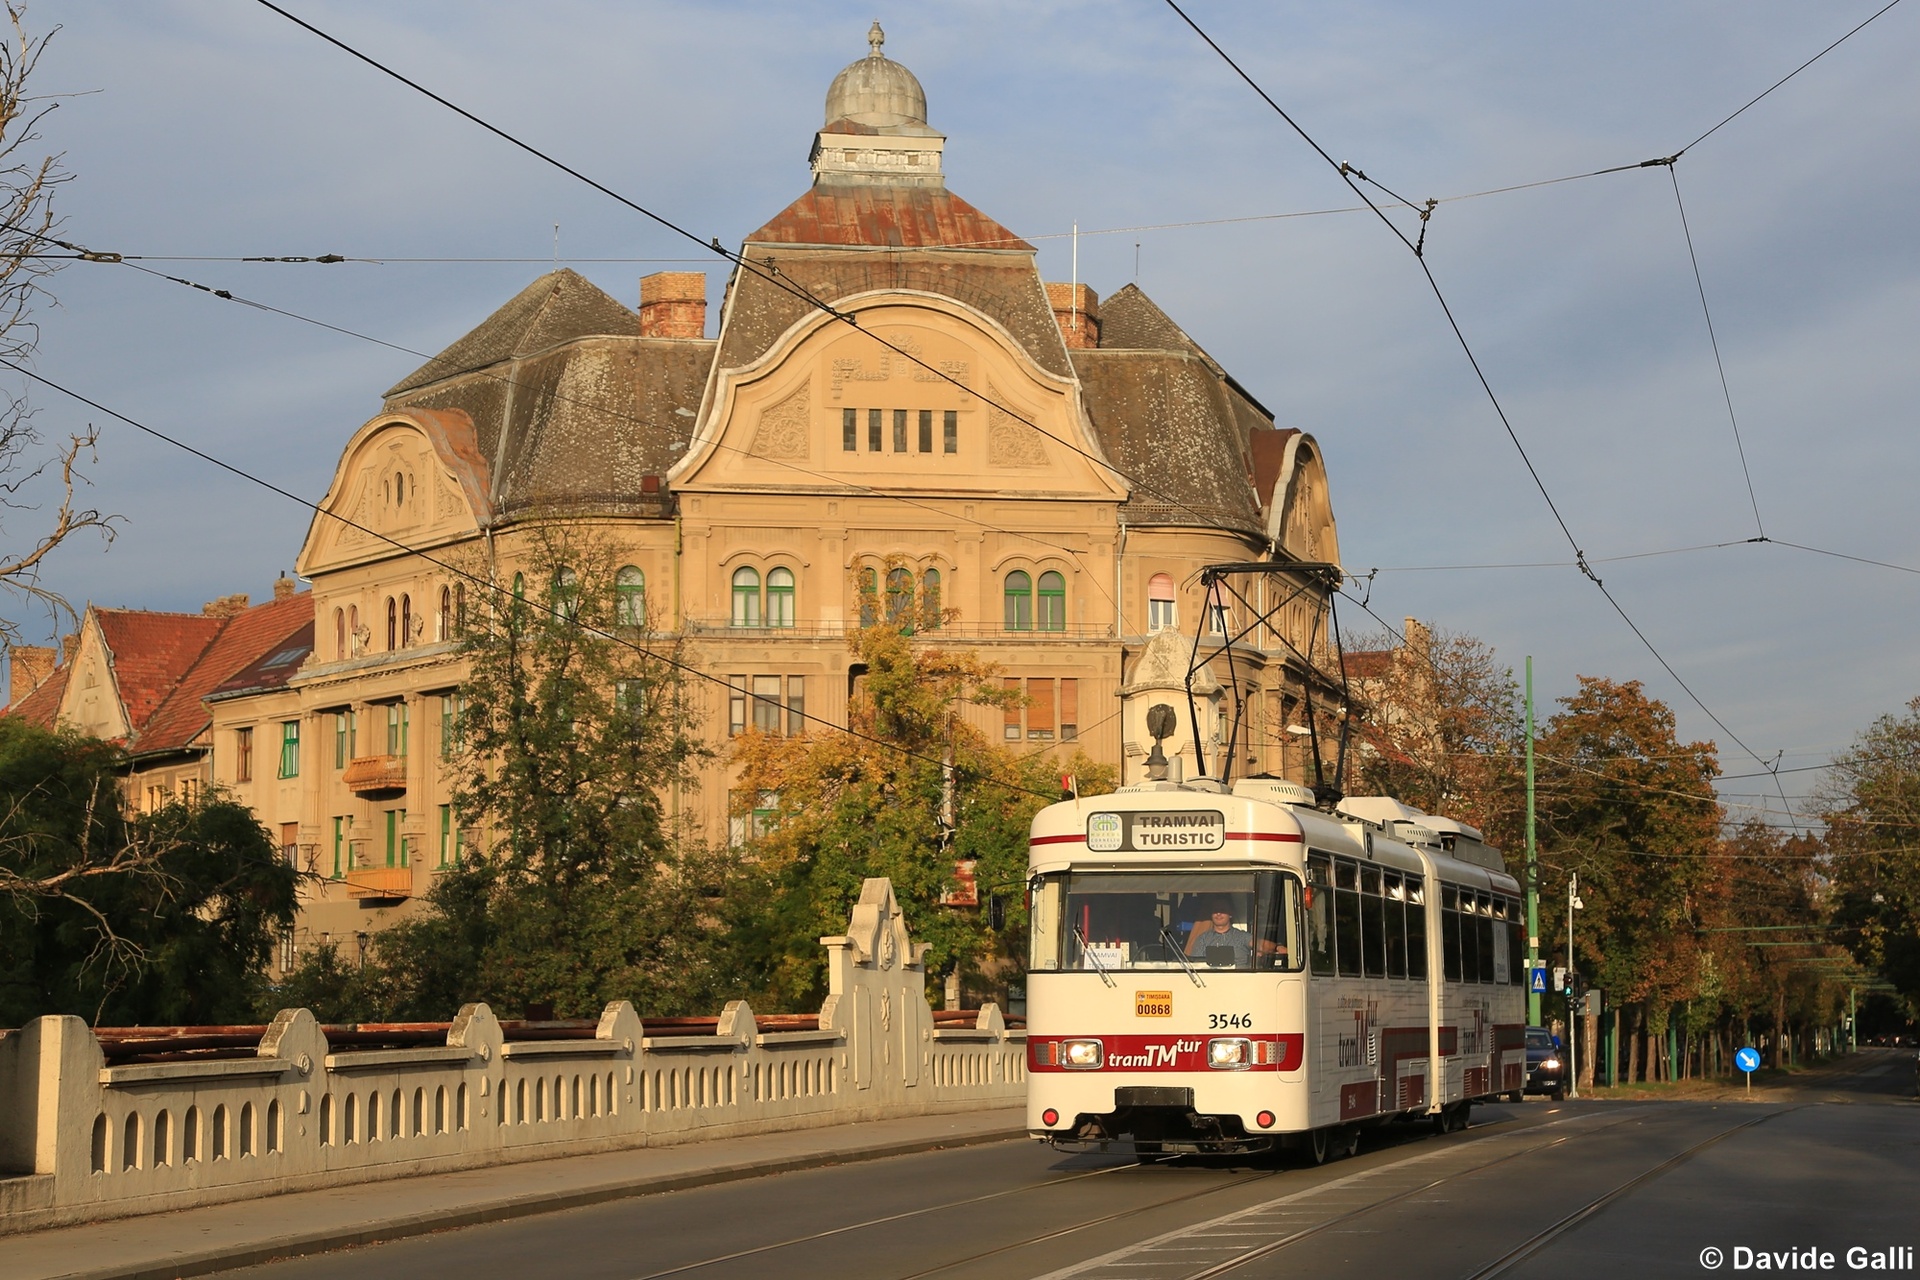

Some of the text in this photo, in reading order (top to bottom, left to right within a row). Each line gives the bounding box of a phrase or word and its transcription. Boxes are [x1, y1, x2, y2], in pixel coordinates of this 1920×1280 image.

[1140, 816, 1214, 828] TRAMVAI
[1140, 833, 1215, 845] TURISTIC
[1137, 1004, 1170, 1015] 00868
[1208, 1013, 1252, 1029] 3546
